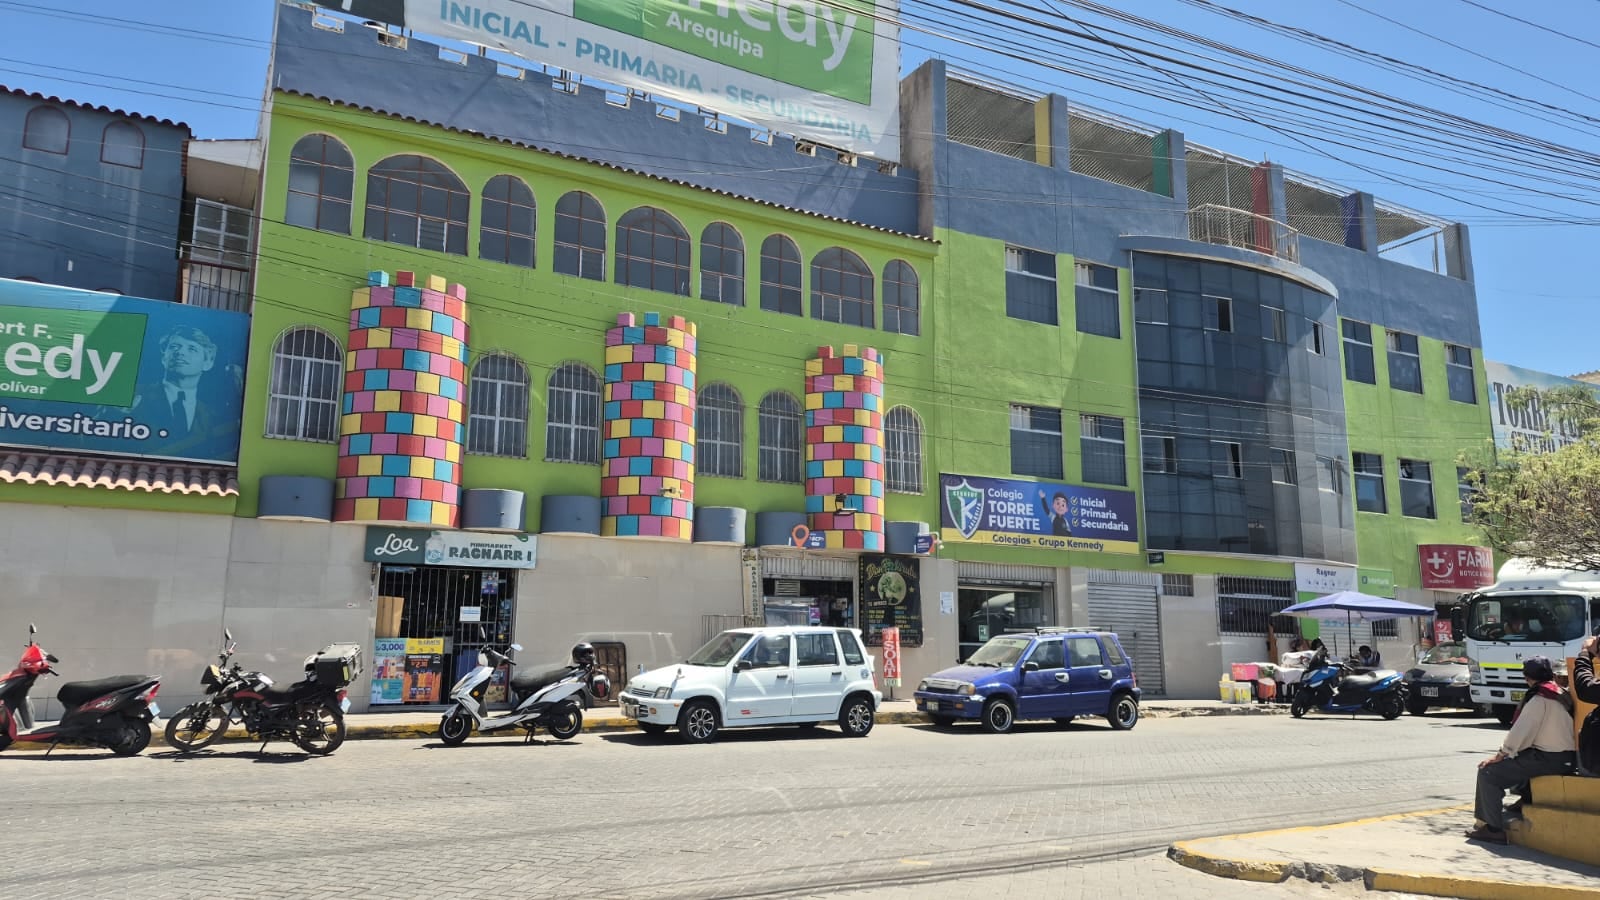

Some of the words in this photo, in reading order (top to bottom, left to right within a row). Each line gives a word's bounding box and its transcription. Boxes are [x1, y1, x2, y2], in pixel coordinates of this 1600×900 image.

[665, 10, 764, 59] Arequipa
[440, 0, 550, 48] INICIAL
[575, 37, 704, 94] PRIMARIA
[725, 84, 873, 142] SECUNDARIA
[33, 324, 52, 339] F.
[5, 333, 123, 395] edy
[0, 406, 151, 440] iversitario
[987, 488, 1023, 501] Colegio
[1080, 497, 1106, 508] Inicial
[988, 500, 1034, 516] TORRE
[1081, 508, 1117, 520] Primaria
[988, 514, 1041, 531] FUERTE
[1081, 519, 1129, 531] Secundaria
[374, 533, 419, 555] Loa
[992, 534, 1031, 546] Colegios
[1038, 537, 1065, 548] Grupo
[1067, 540, 1104, 552] Kennedy
[449, 547, 523, 561] RAGNARR
[883, 640, 897, 678] SOAT
